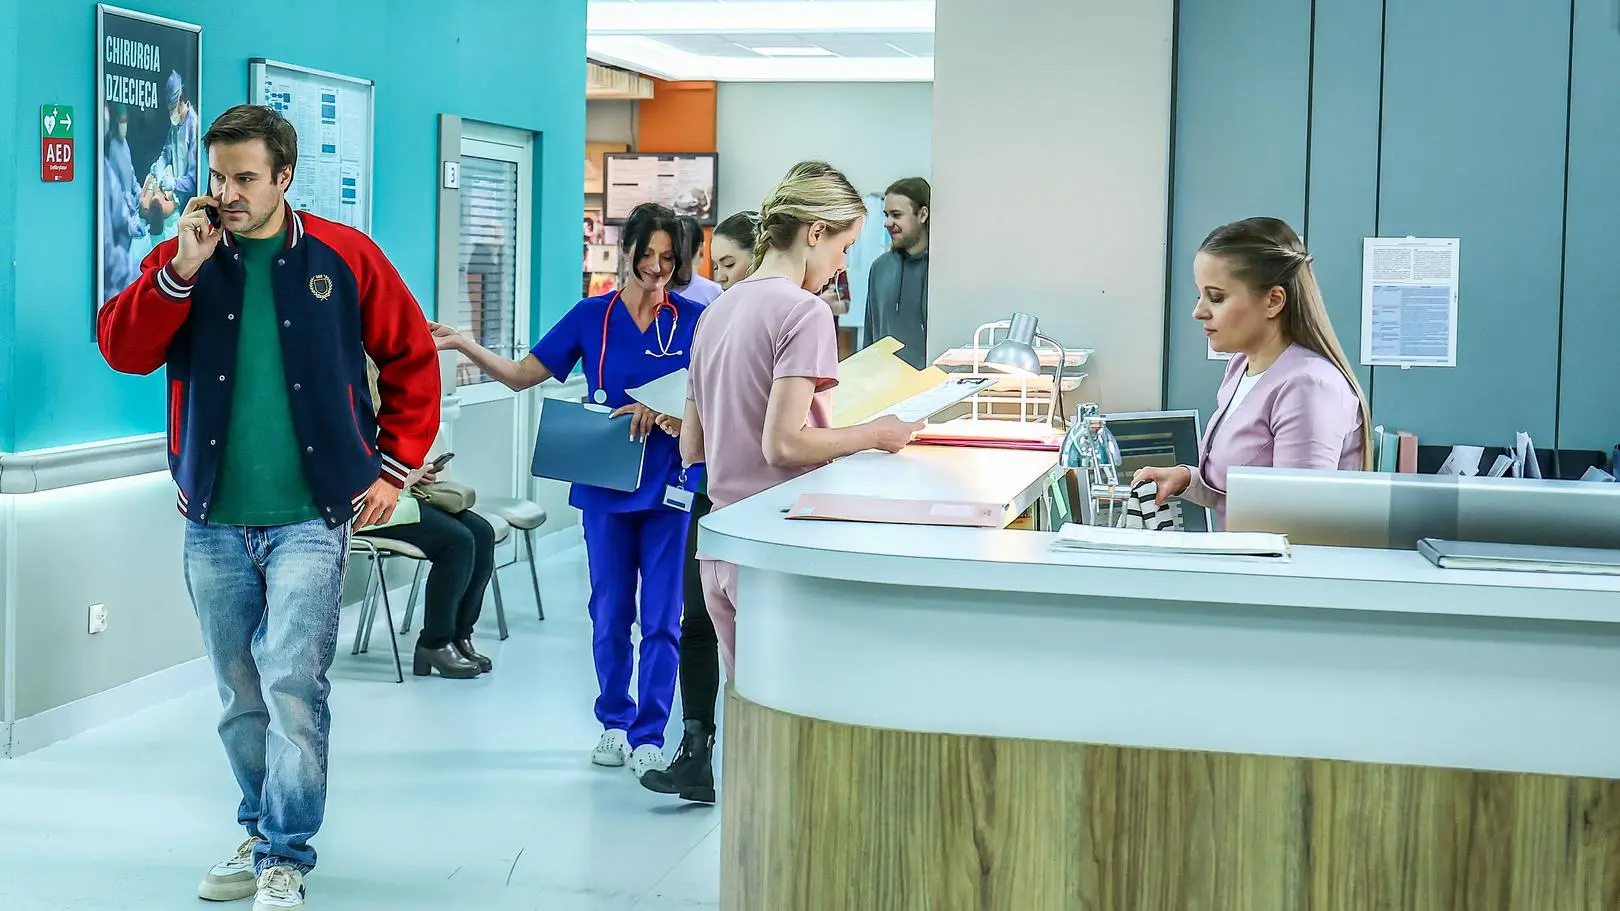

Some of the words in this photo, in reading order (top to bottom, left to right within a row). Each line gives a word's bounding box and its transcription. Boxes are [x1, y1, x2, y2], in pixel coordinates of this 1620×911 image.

[106, 35, 160, 72] CHIRURGIA
[106, 74, 158, 111] DZIECIĘCA
[46, 143, 71, 163] AED
[450, 167, 456, 183] 3
